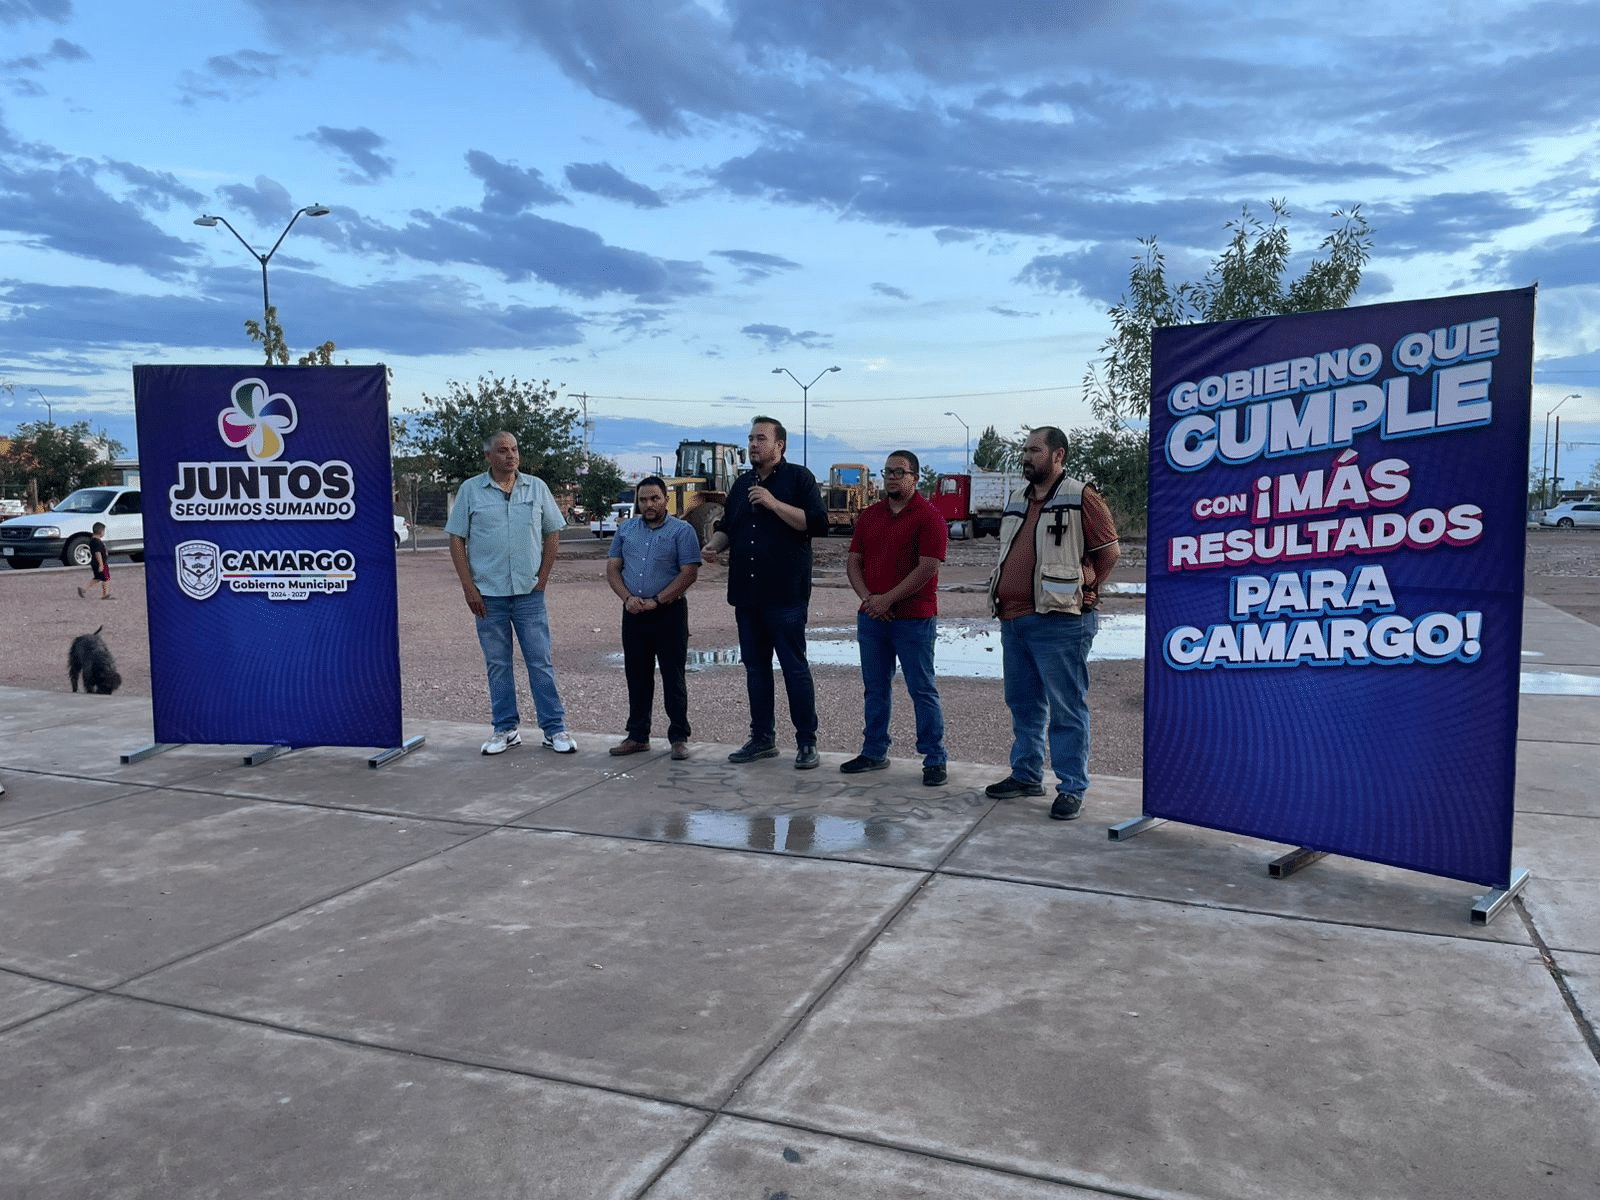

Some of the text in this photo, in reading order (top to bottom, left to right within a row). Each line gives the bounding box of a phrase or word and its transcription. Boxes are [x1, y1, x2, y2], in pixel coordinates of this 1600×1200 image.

[1170, 317, 1499, 413] GOBIERNO QUE
[1167, 361, 1492, 469] CUMPLE
[174, 465, 351, 500] JUNTOS
[175, 502, 352, 516] SEGUIMOS SUMANDO
[1194, 449, 1411, 519] CON ¡MÁS
[222, 553, 353, 571] CAMARGO
[1170, 504, 1483, 568] RESULTADOS
[232, 580, 345, 592] Gobierno Municipal
[1235, 564, 1395, 616] PARA
[1167, 611, 1483, 666] CAMARGO!
